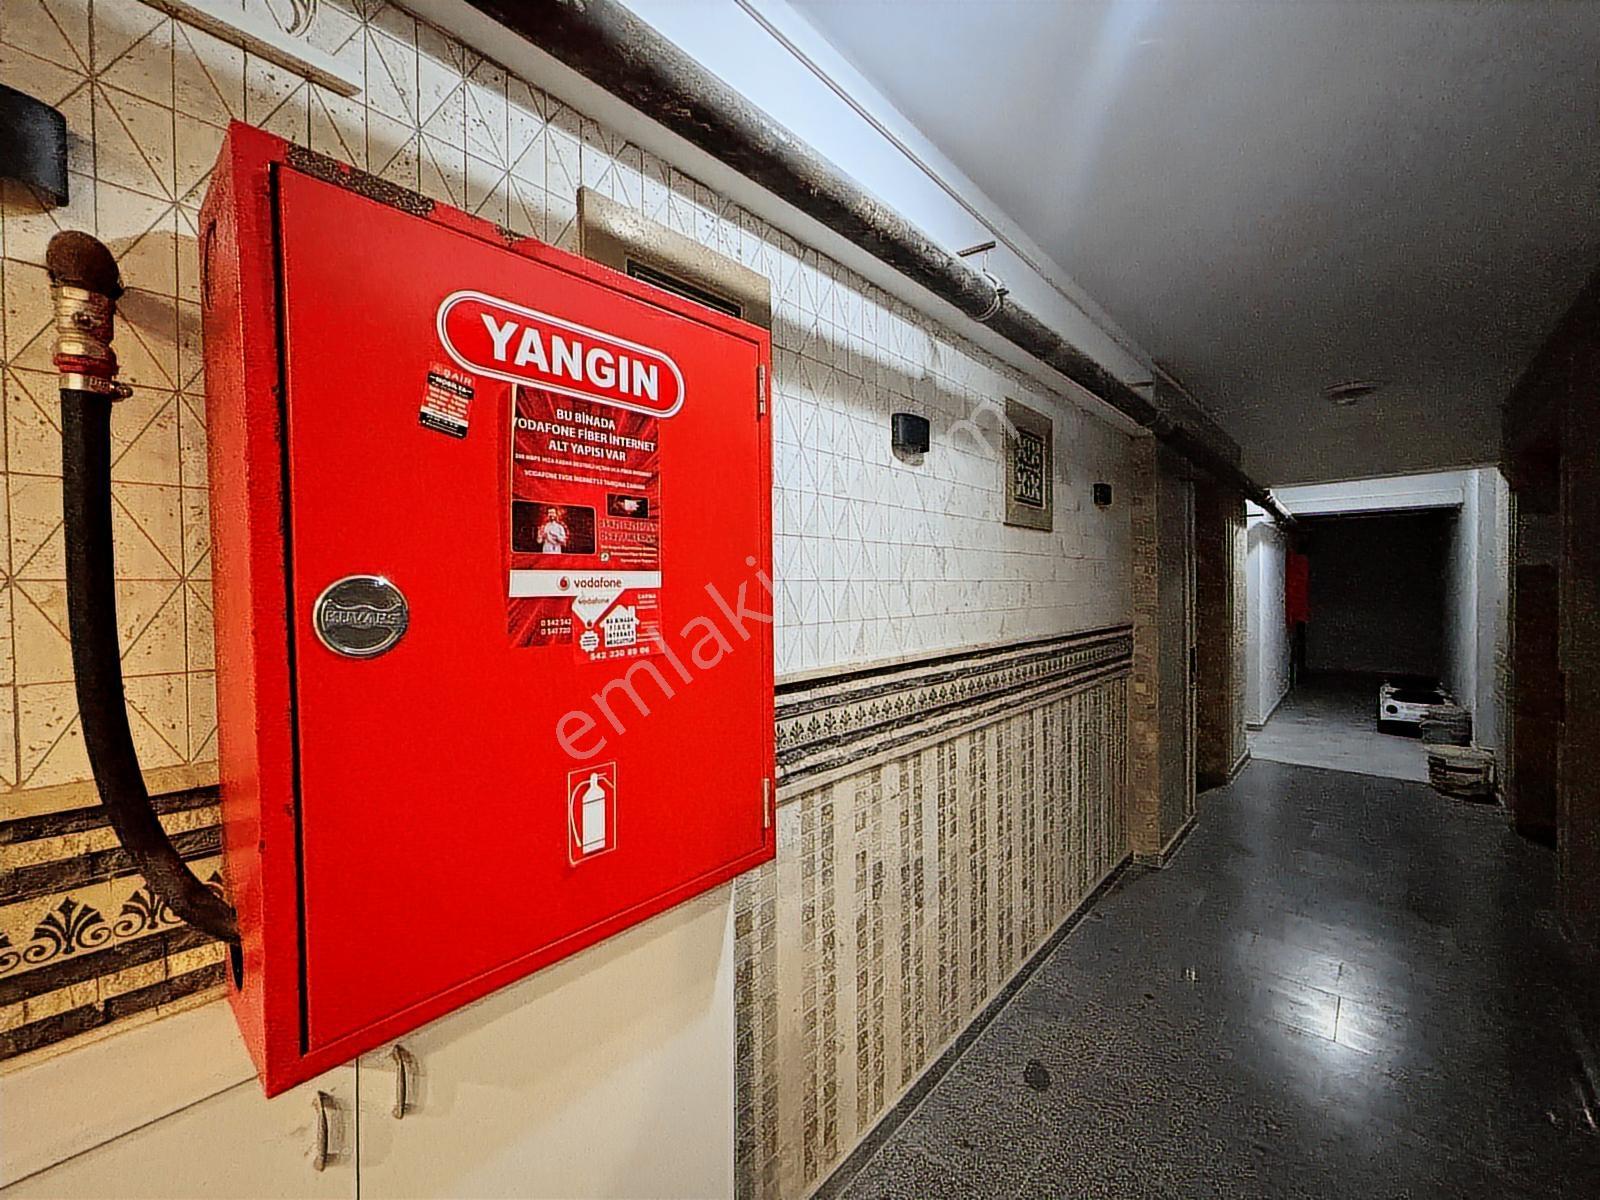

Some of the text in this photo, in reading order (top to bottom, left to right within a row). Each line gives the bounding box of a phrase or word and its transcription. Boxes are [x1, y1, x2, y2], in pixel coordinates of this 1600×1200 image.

[480, 313, 659, 401] YANGIN
[556, 408, 616, 430] BU BİNADA
[548, 440, 626, 461] ALT YAPISI VAR
[578, 428, 608, 444] FİBER
[609, 433, 656, 452] İNTERNET
[573, 576, 622, 589] vodafone
